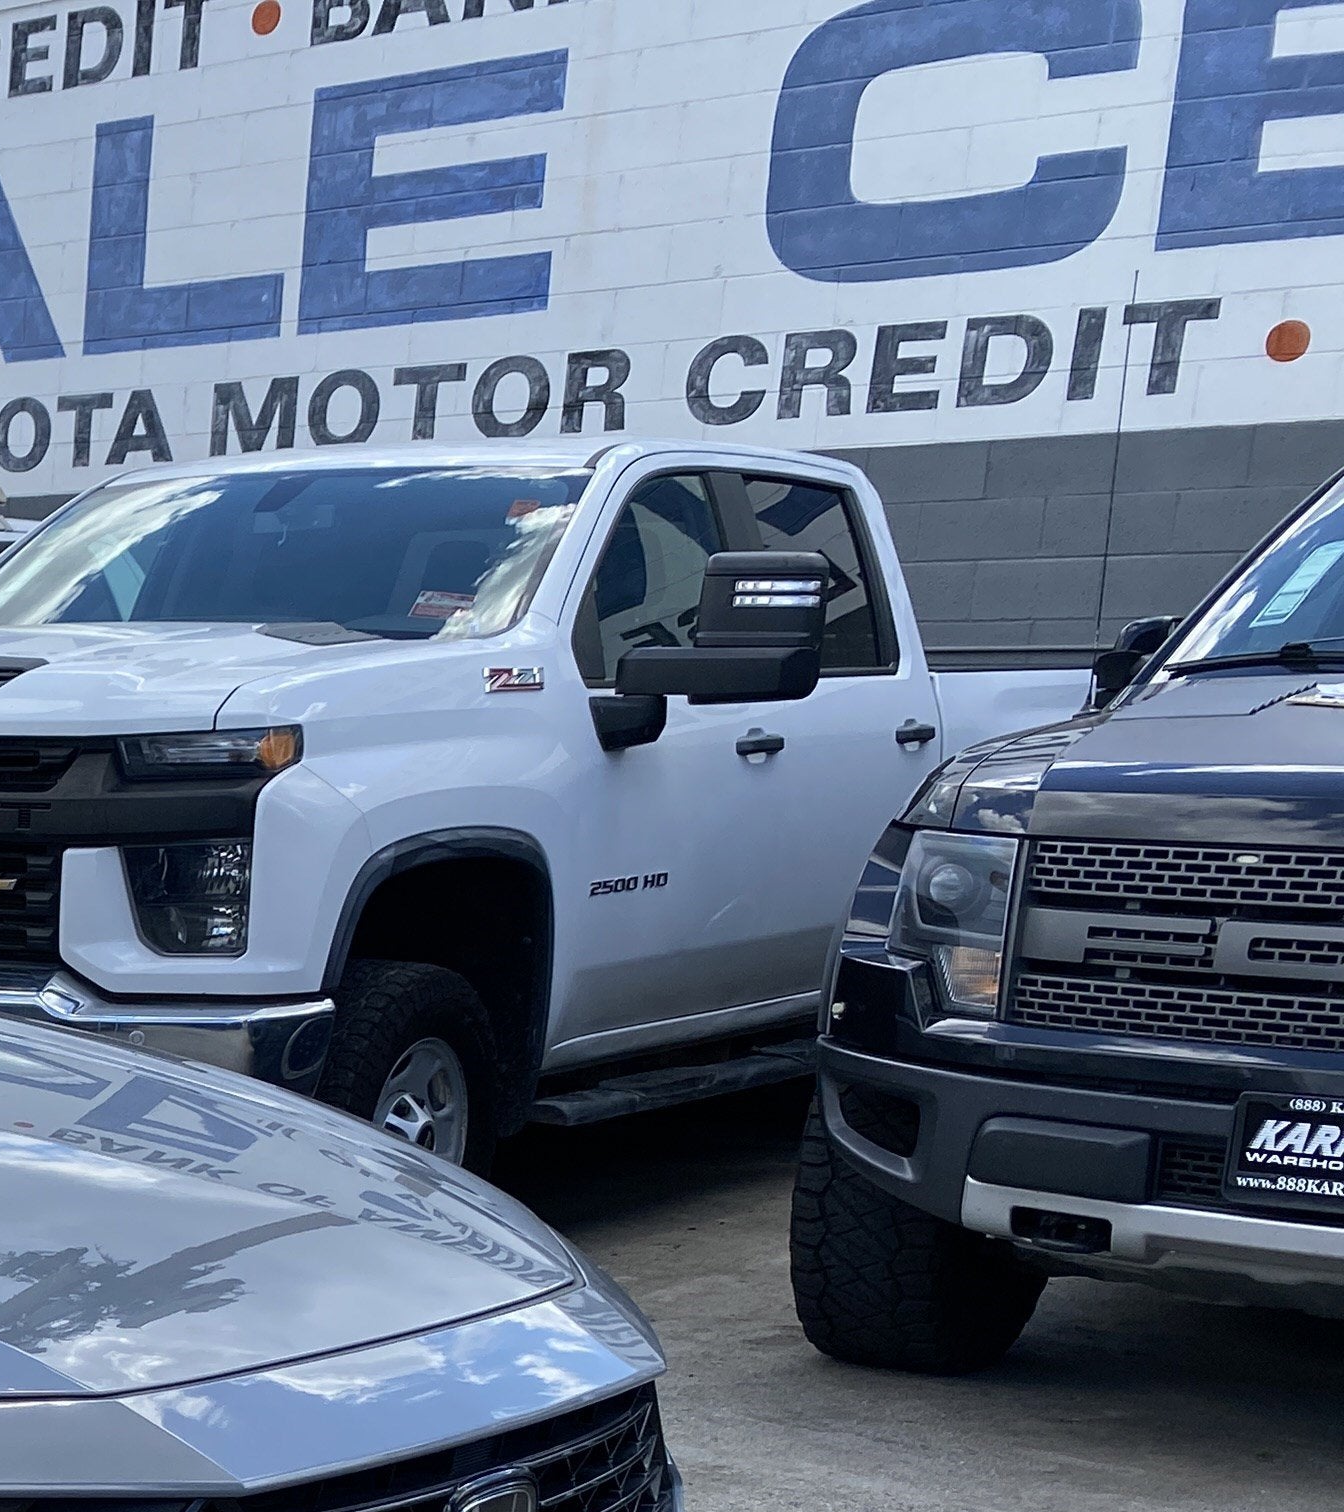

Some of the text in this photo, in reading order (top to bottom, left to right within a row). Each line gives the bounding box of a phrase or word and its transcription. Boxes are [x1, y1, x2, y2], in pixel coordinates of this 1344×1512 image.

[210, 349, 632, 458] MOTOR
[686, 298, 1221, 425] CREDIT
[589, 871, 668, 898] 2500 HD
[1289, 1098, 1327, 1112] (888)
[1246, 1119, 1344, 1157] KAR
[1245, 1151, 1344, 1171] WAREHO
